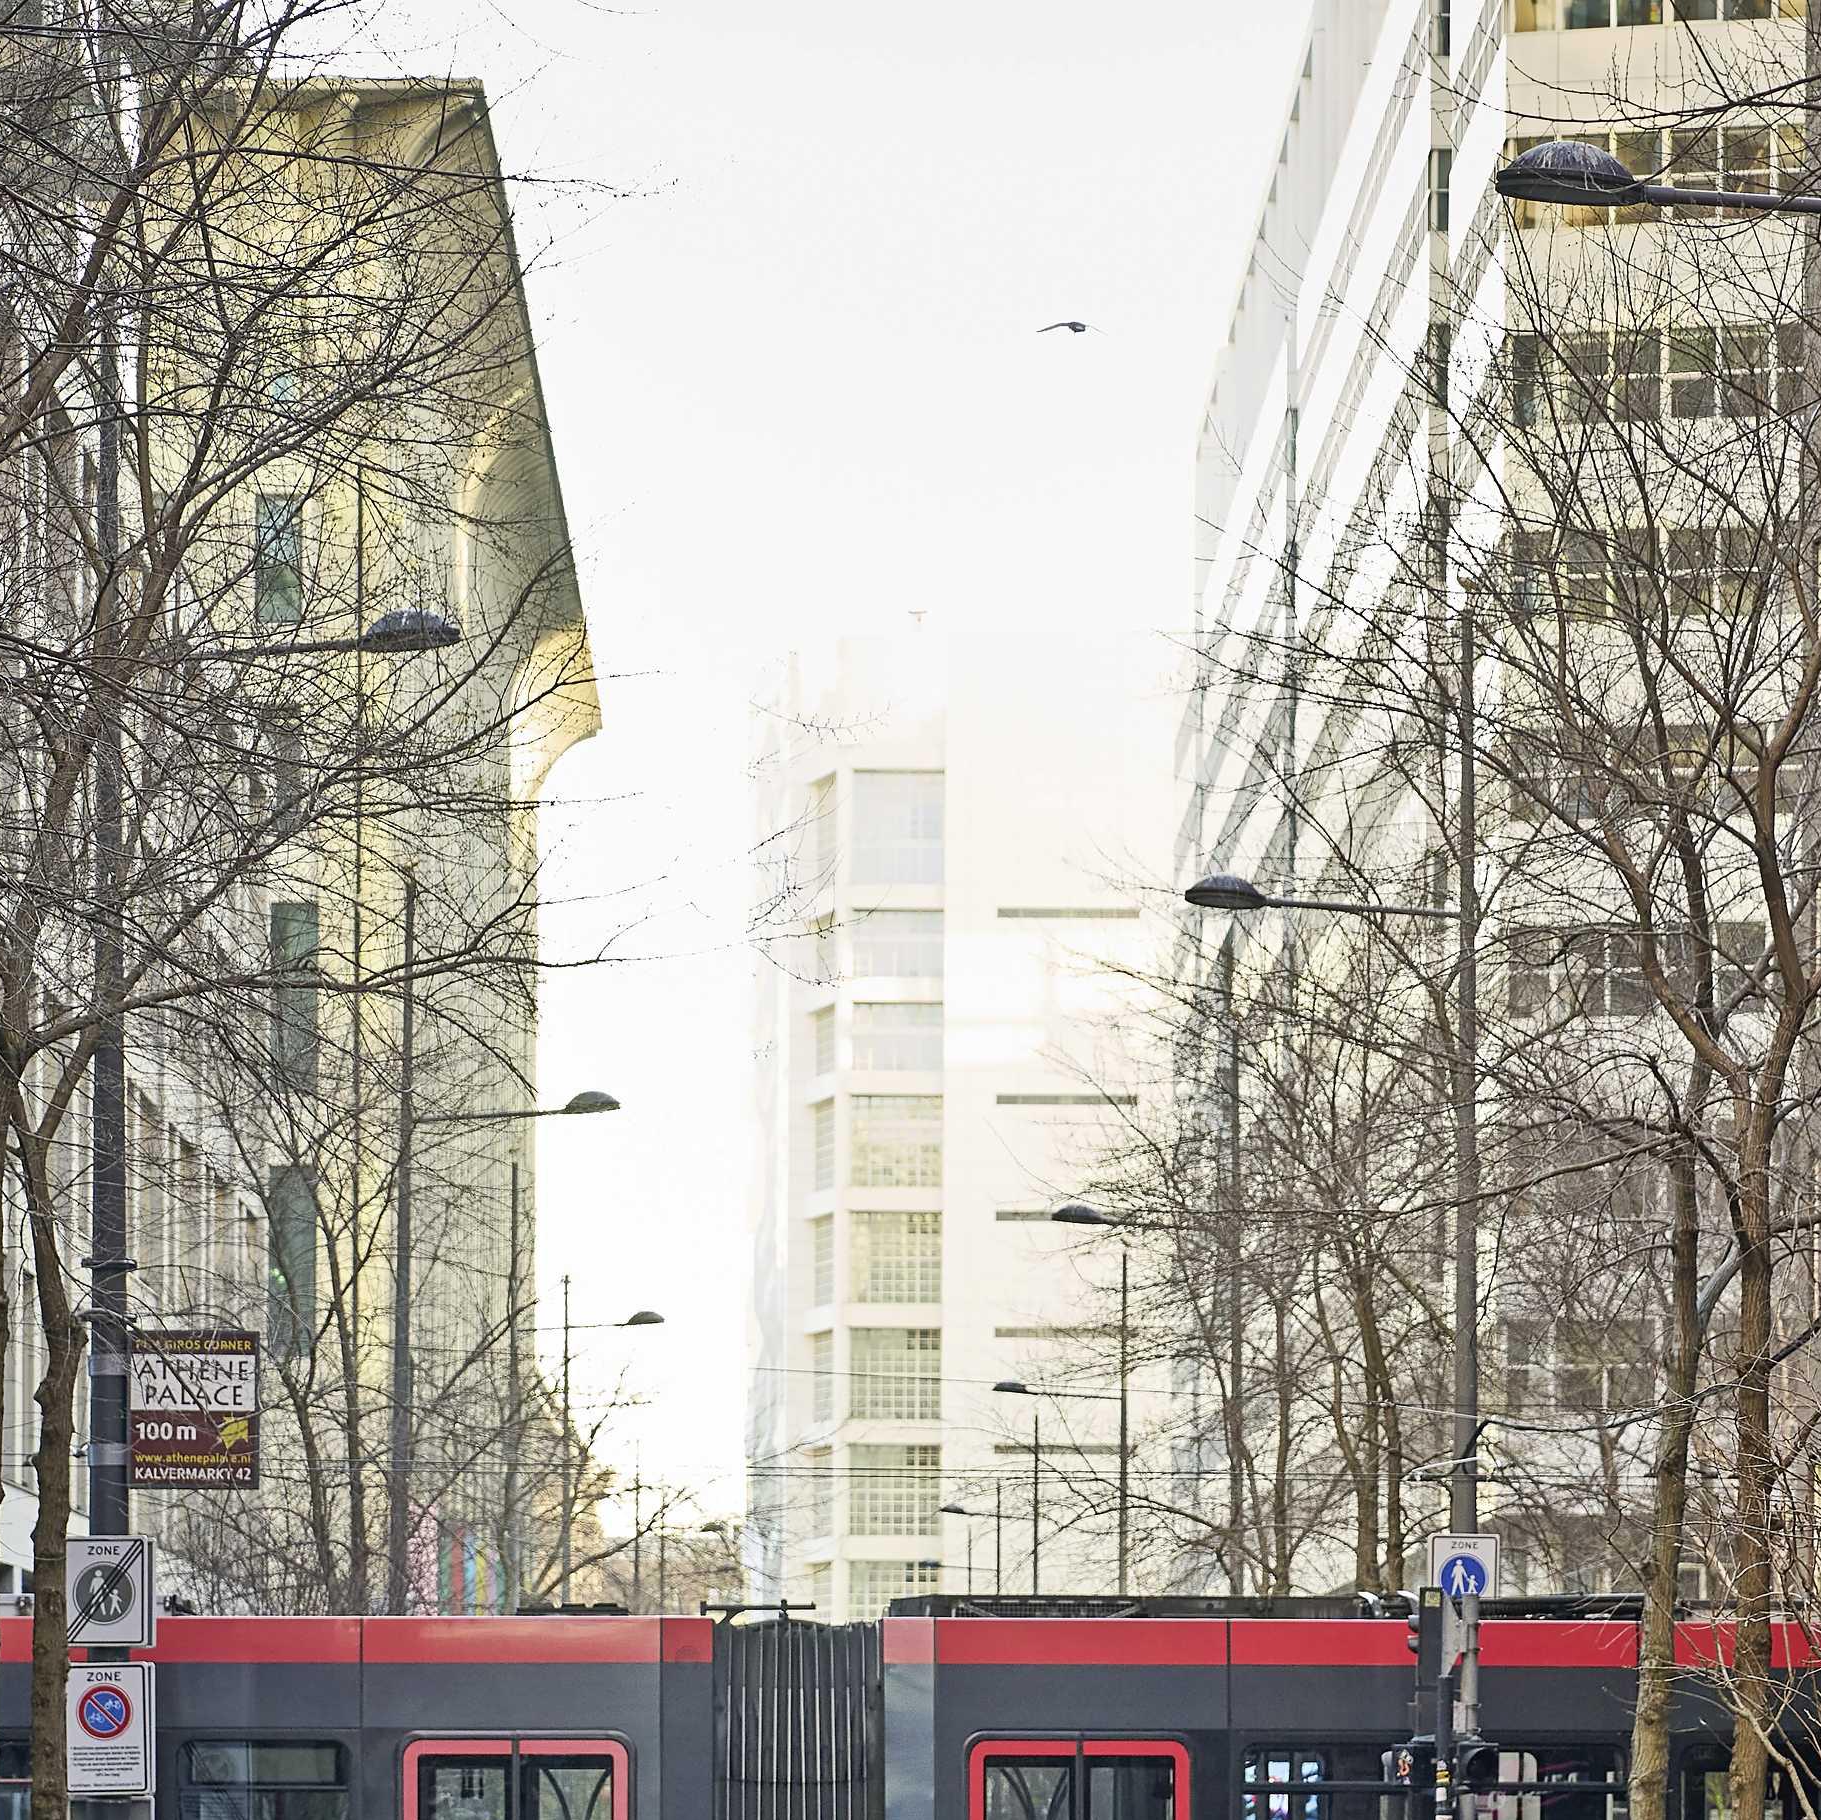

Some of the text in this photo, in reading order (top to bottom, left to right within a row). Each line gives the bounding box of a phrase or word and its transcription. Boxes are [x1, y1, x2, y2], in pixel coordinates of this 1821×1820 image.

[164, 1340, 201, 1350] GIROS
[138, 1360, 249, 1380] ATHENE
[146, 1385, 243, 1405] PALACE
[135, 1422, 197, 1440] 100 m
[135, 1453, 251, 1465] www.athenepalae.nl
[135, 1468, 251, 1480] KALVERMARKT 42
[87, 1545, 120, 1556] ZONE
[1451, 1541, 1479, 1549] ZONE
[87, 1672, 122, 1682] ZONE
